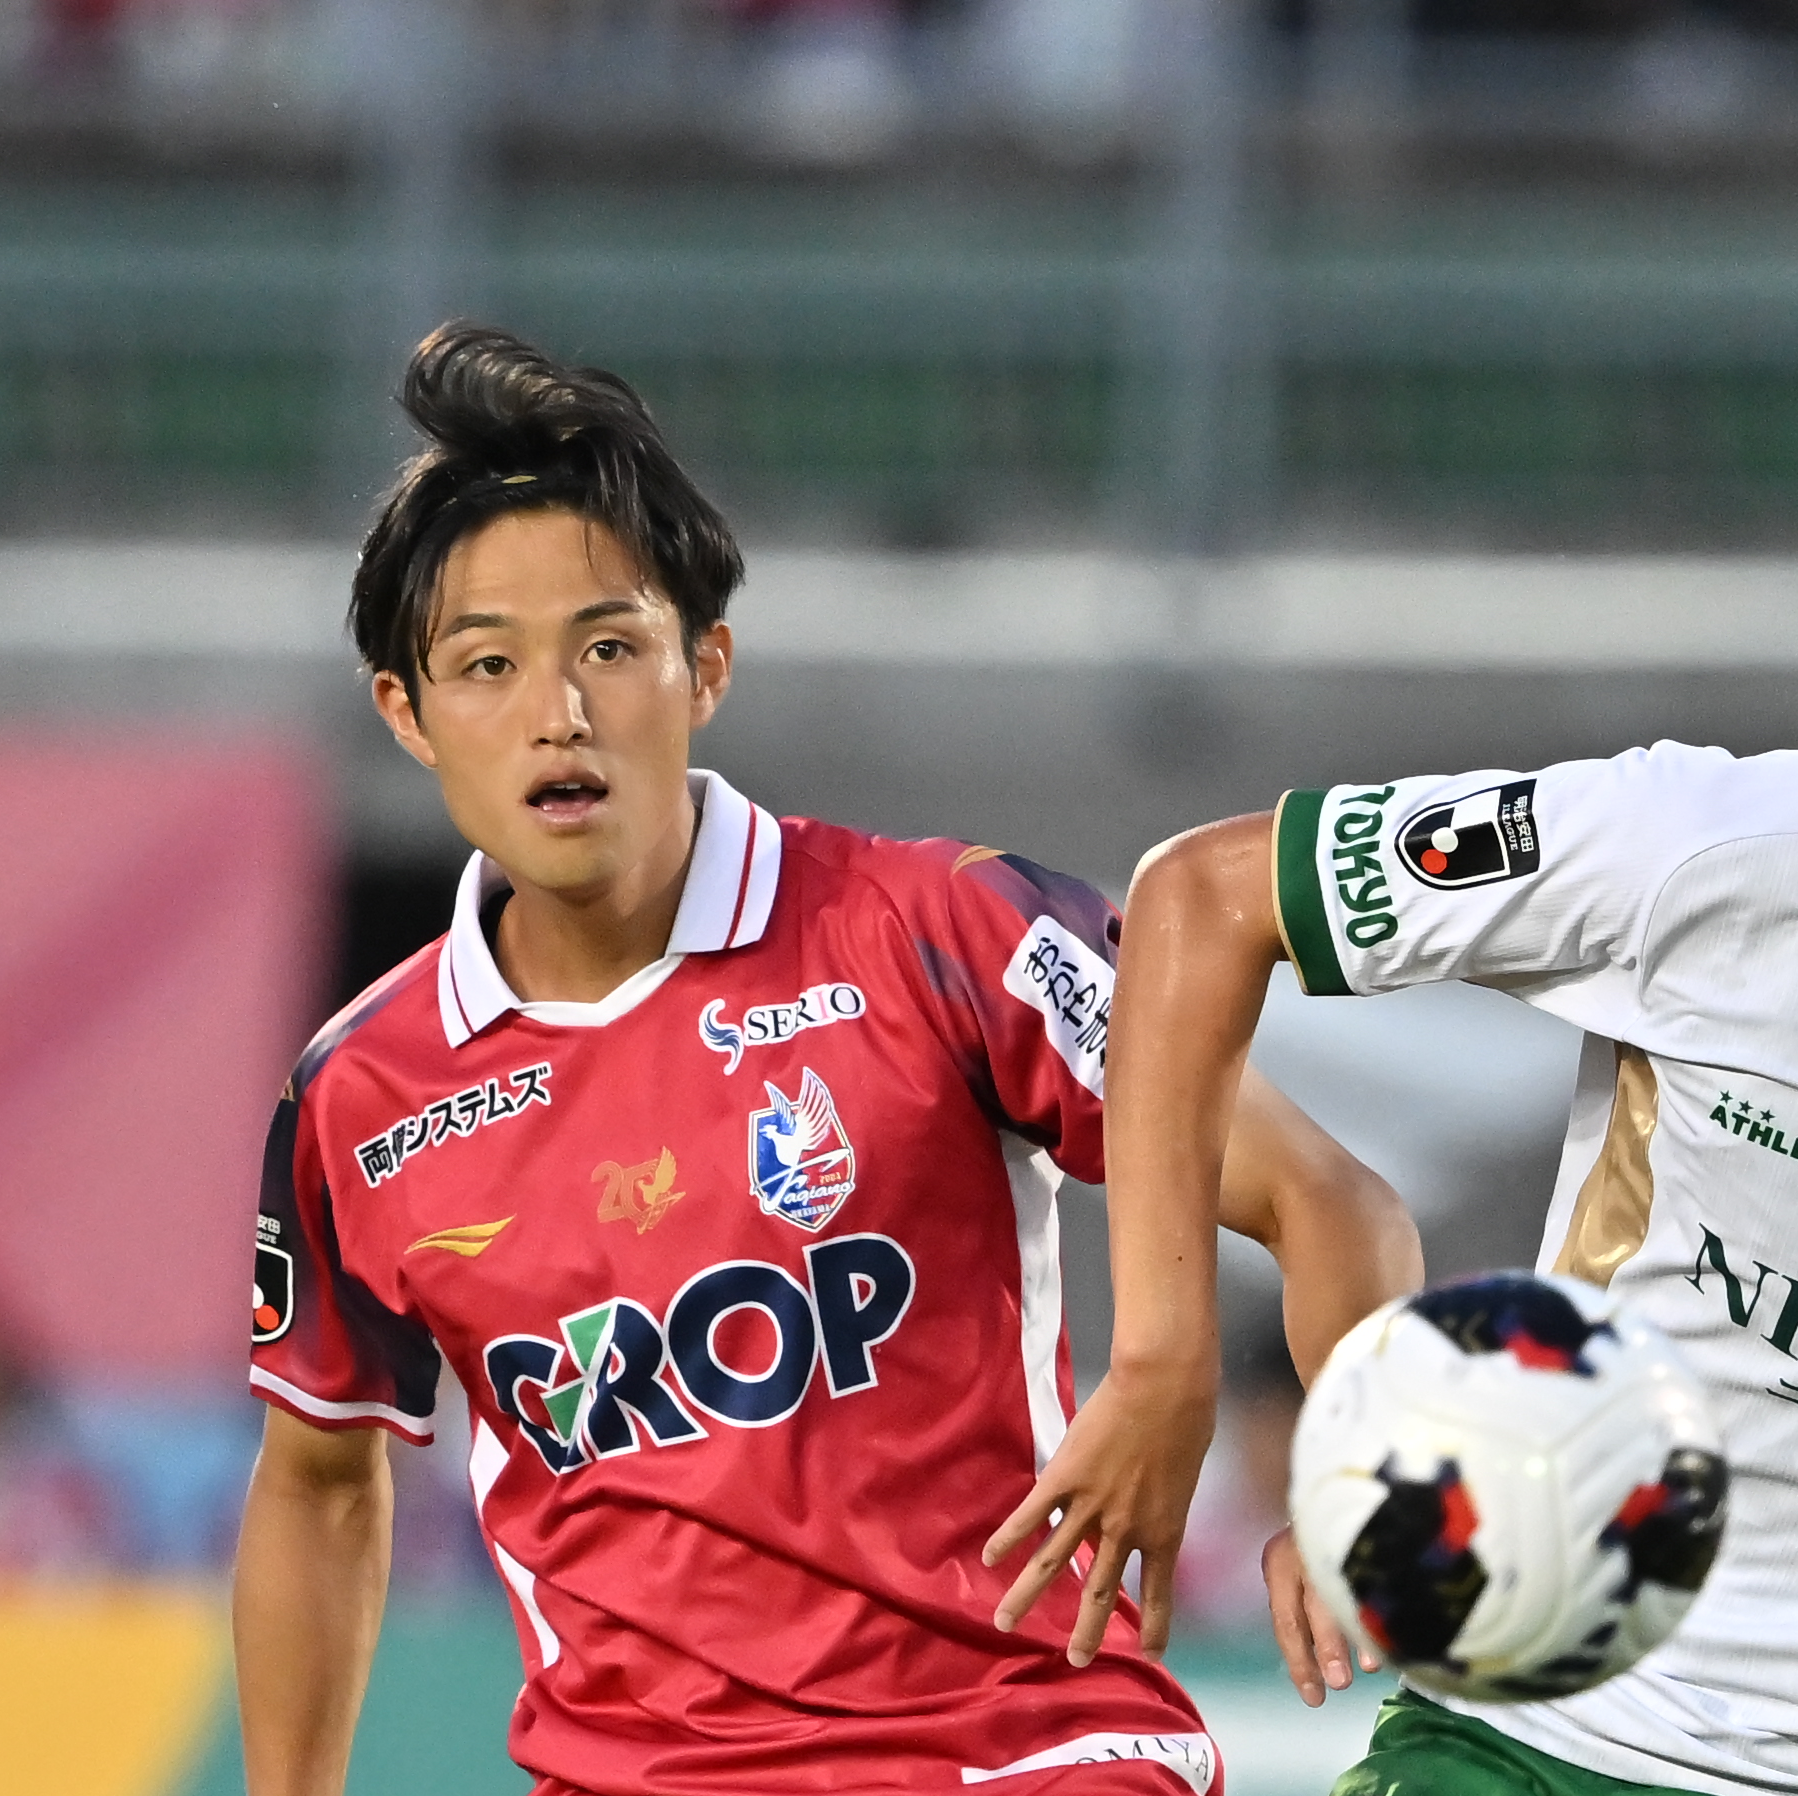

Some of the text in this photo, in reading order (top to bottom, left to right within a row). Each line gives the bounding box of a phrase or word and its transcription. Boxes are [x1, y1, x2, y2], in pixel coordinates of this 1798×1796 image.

[1333, 786, 1399, 949] TOKYO
[747, 986, 861, 1041] SERIO
[1024, 936, 1110, 1068] おかやま
[483, 1233, 916, 1476] GROP
